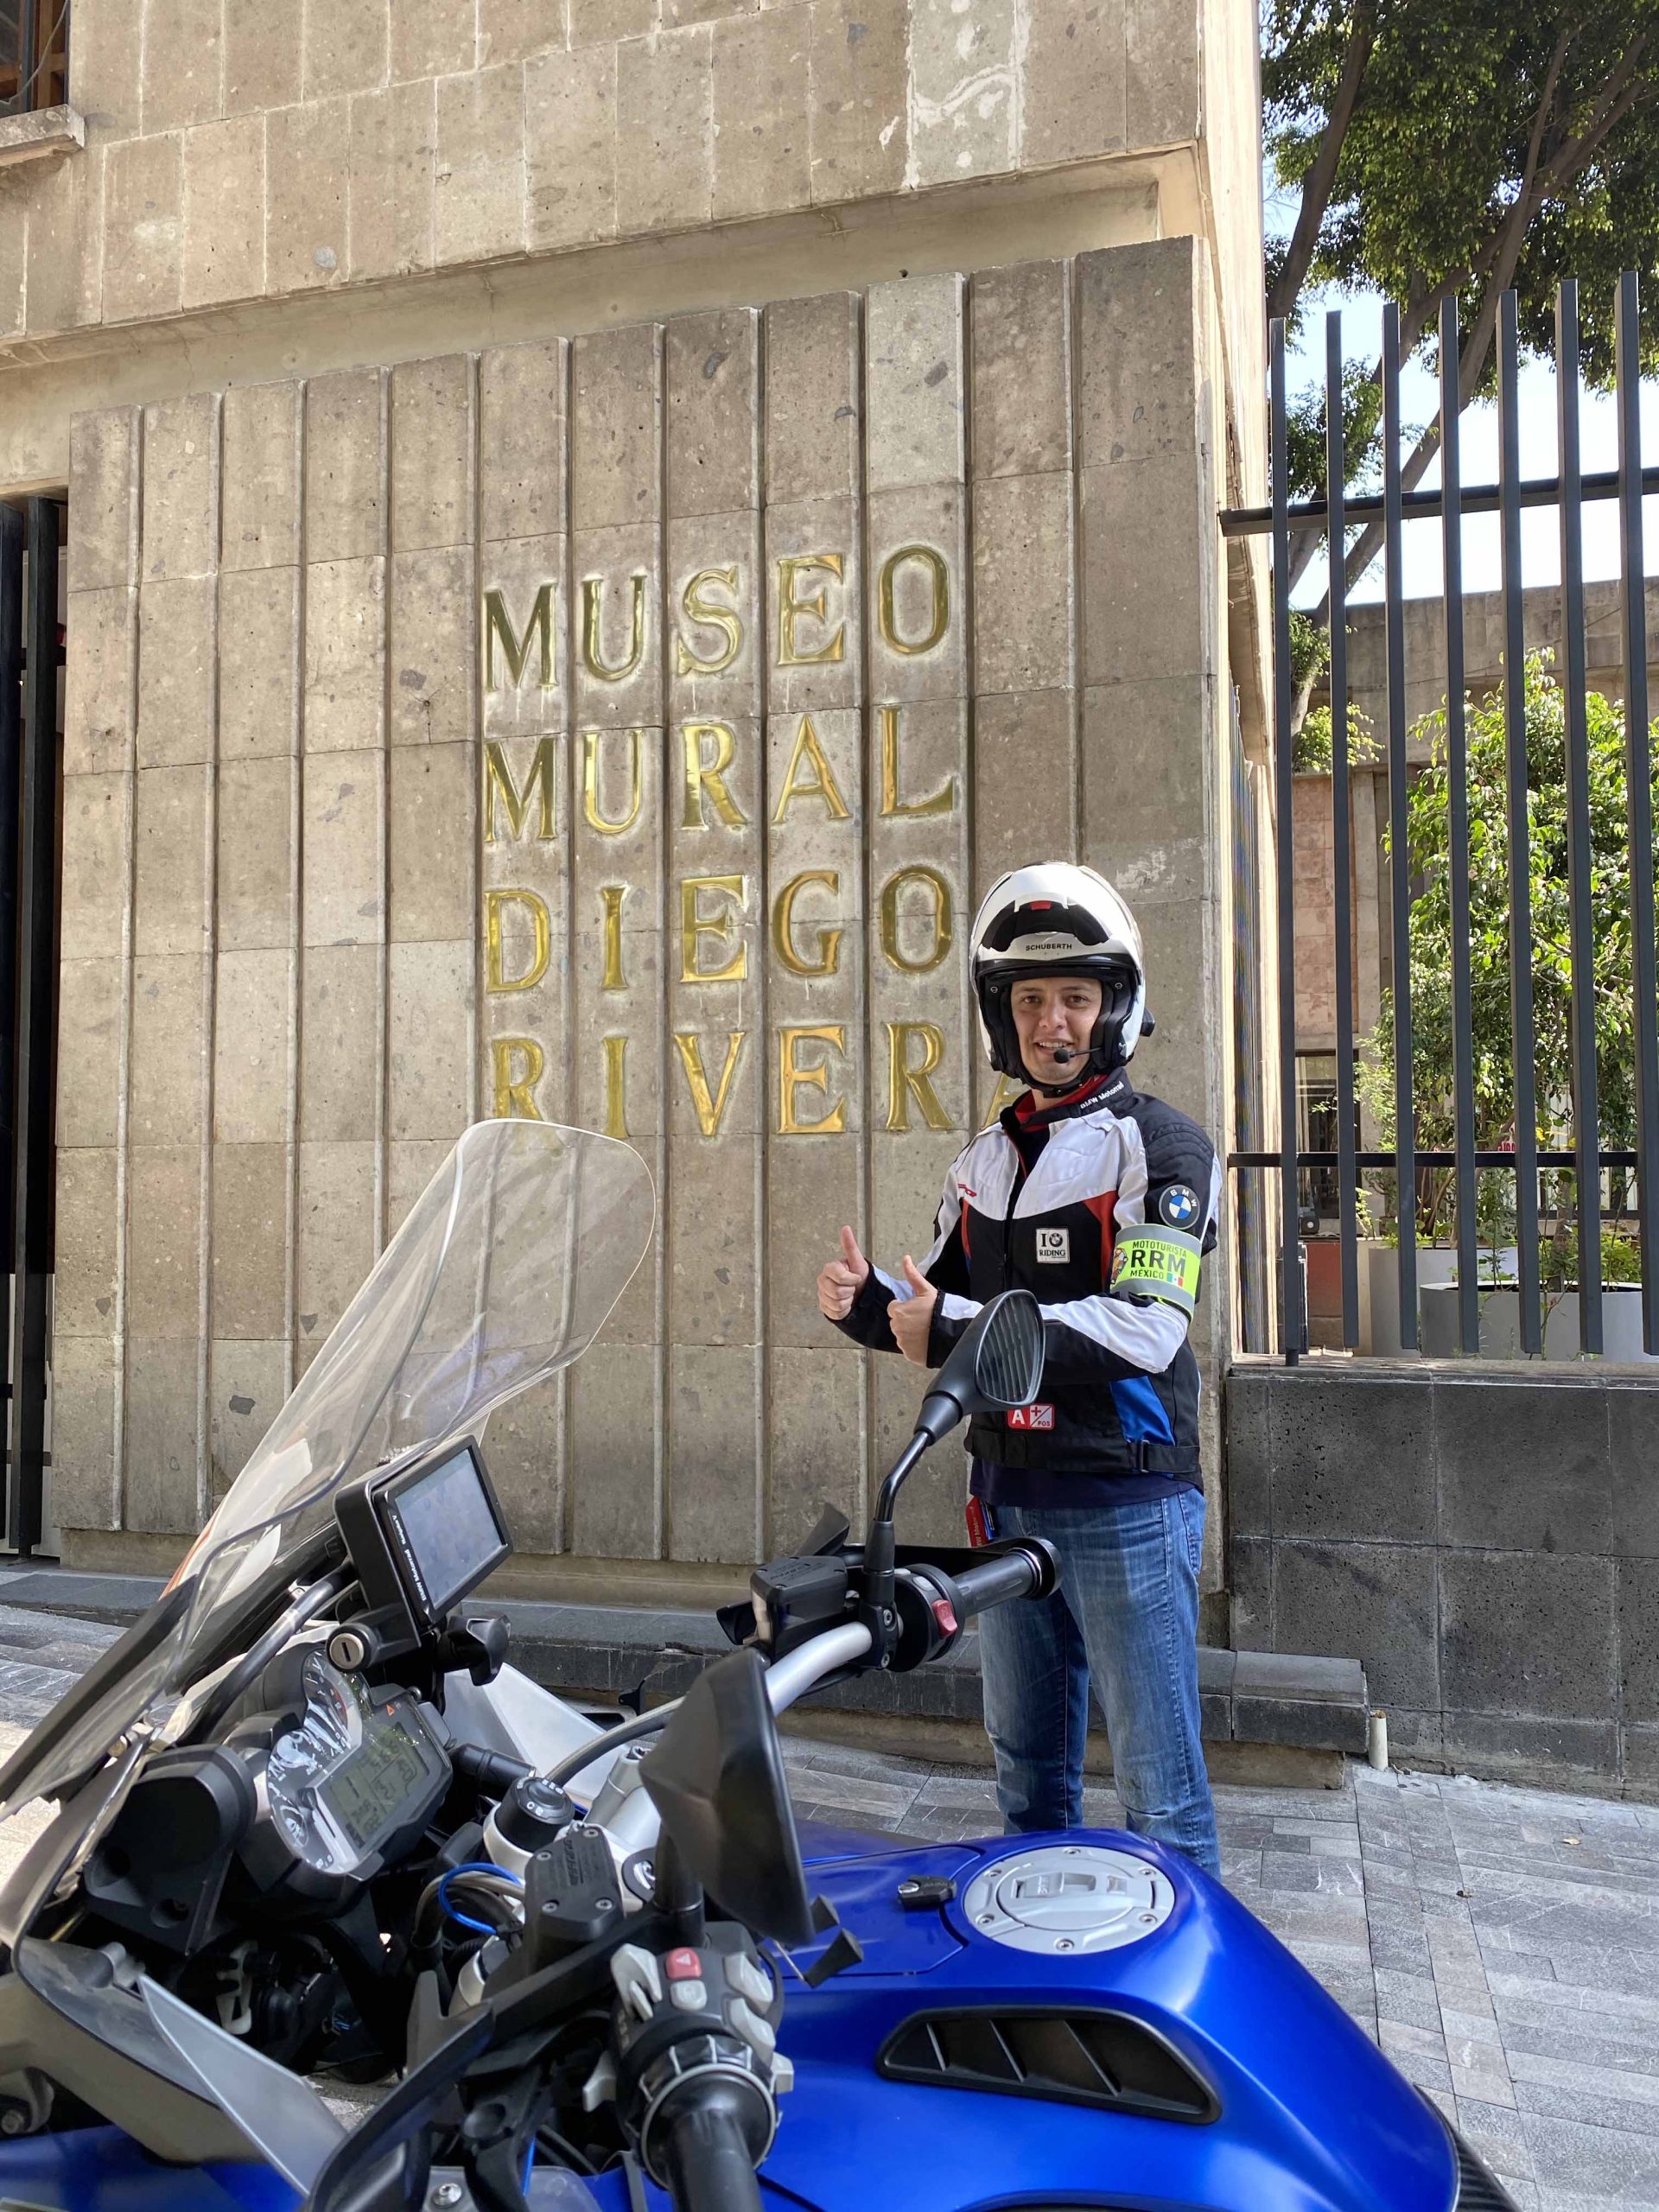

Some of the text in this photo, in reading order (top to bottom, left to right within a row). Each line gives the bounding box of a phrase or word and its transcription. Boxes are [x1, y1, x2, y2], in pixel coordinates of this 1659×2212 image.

[484, 545, 950, 692] MUSEO
[484, 706, 954, 843] MURAL
[484, 865, 952, 993] DIEGO
[1025, 943, 1072, 951] SCHUBERTH
[1039, 1249, 1066, 1257] RIDING
[1132, 1240, 1187, 1259] MOTOTURISTA
[1130, 1249, 1186, 1277] RRM
[1130, 1268, 1165, 1280] MÉXICO
